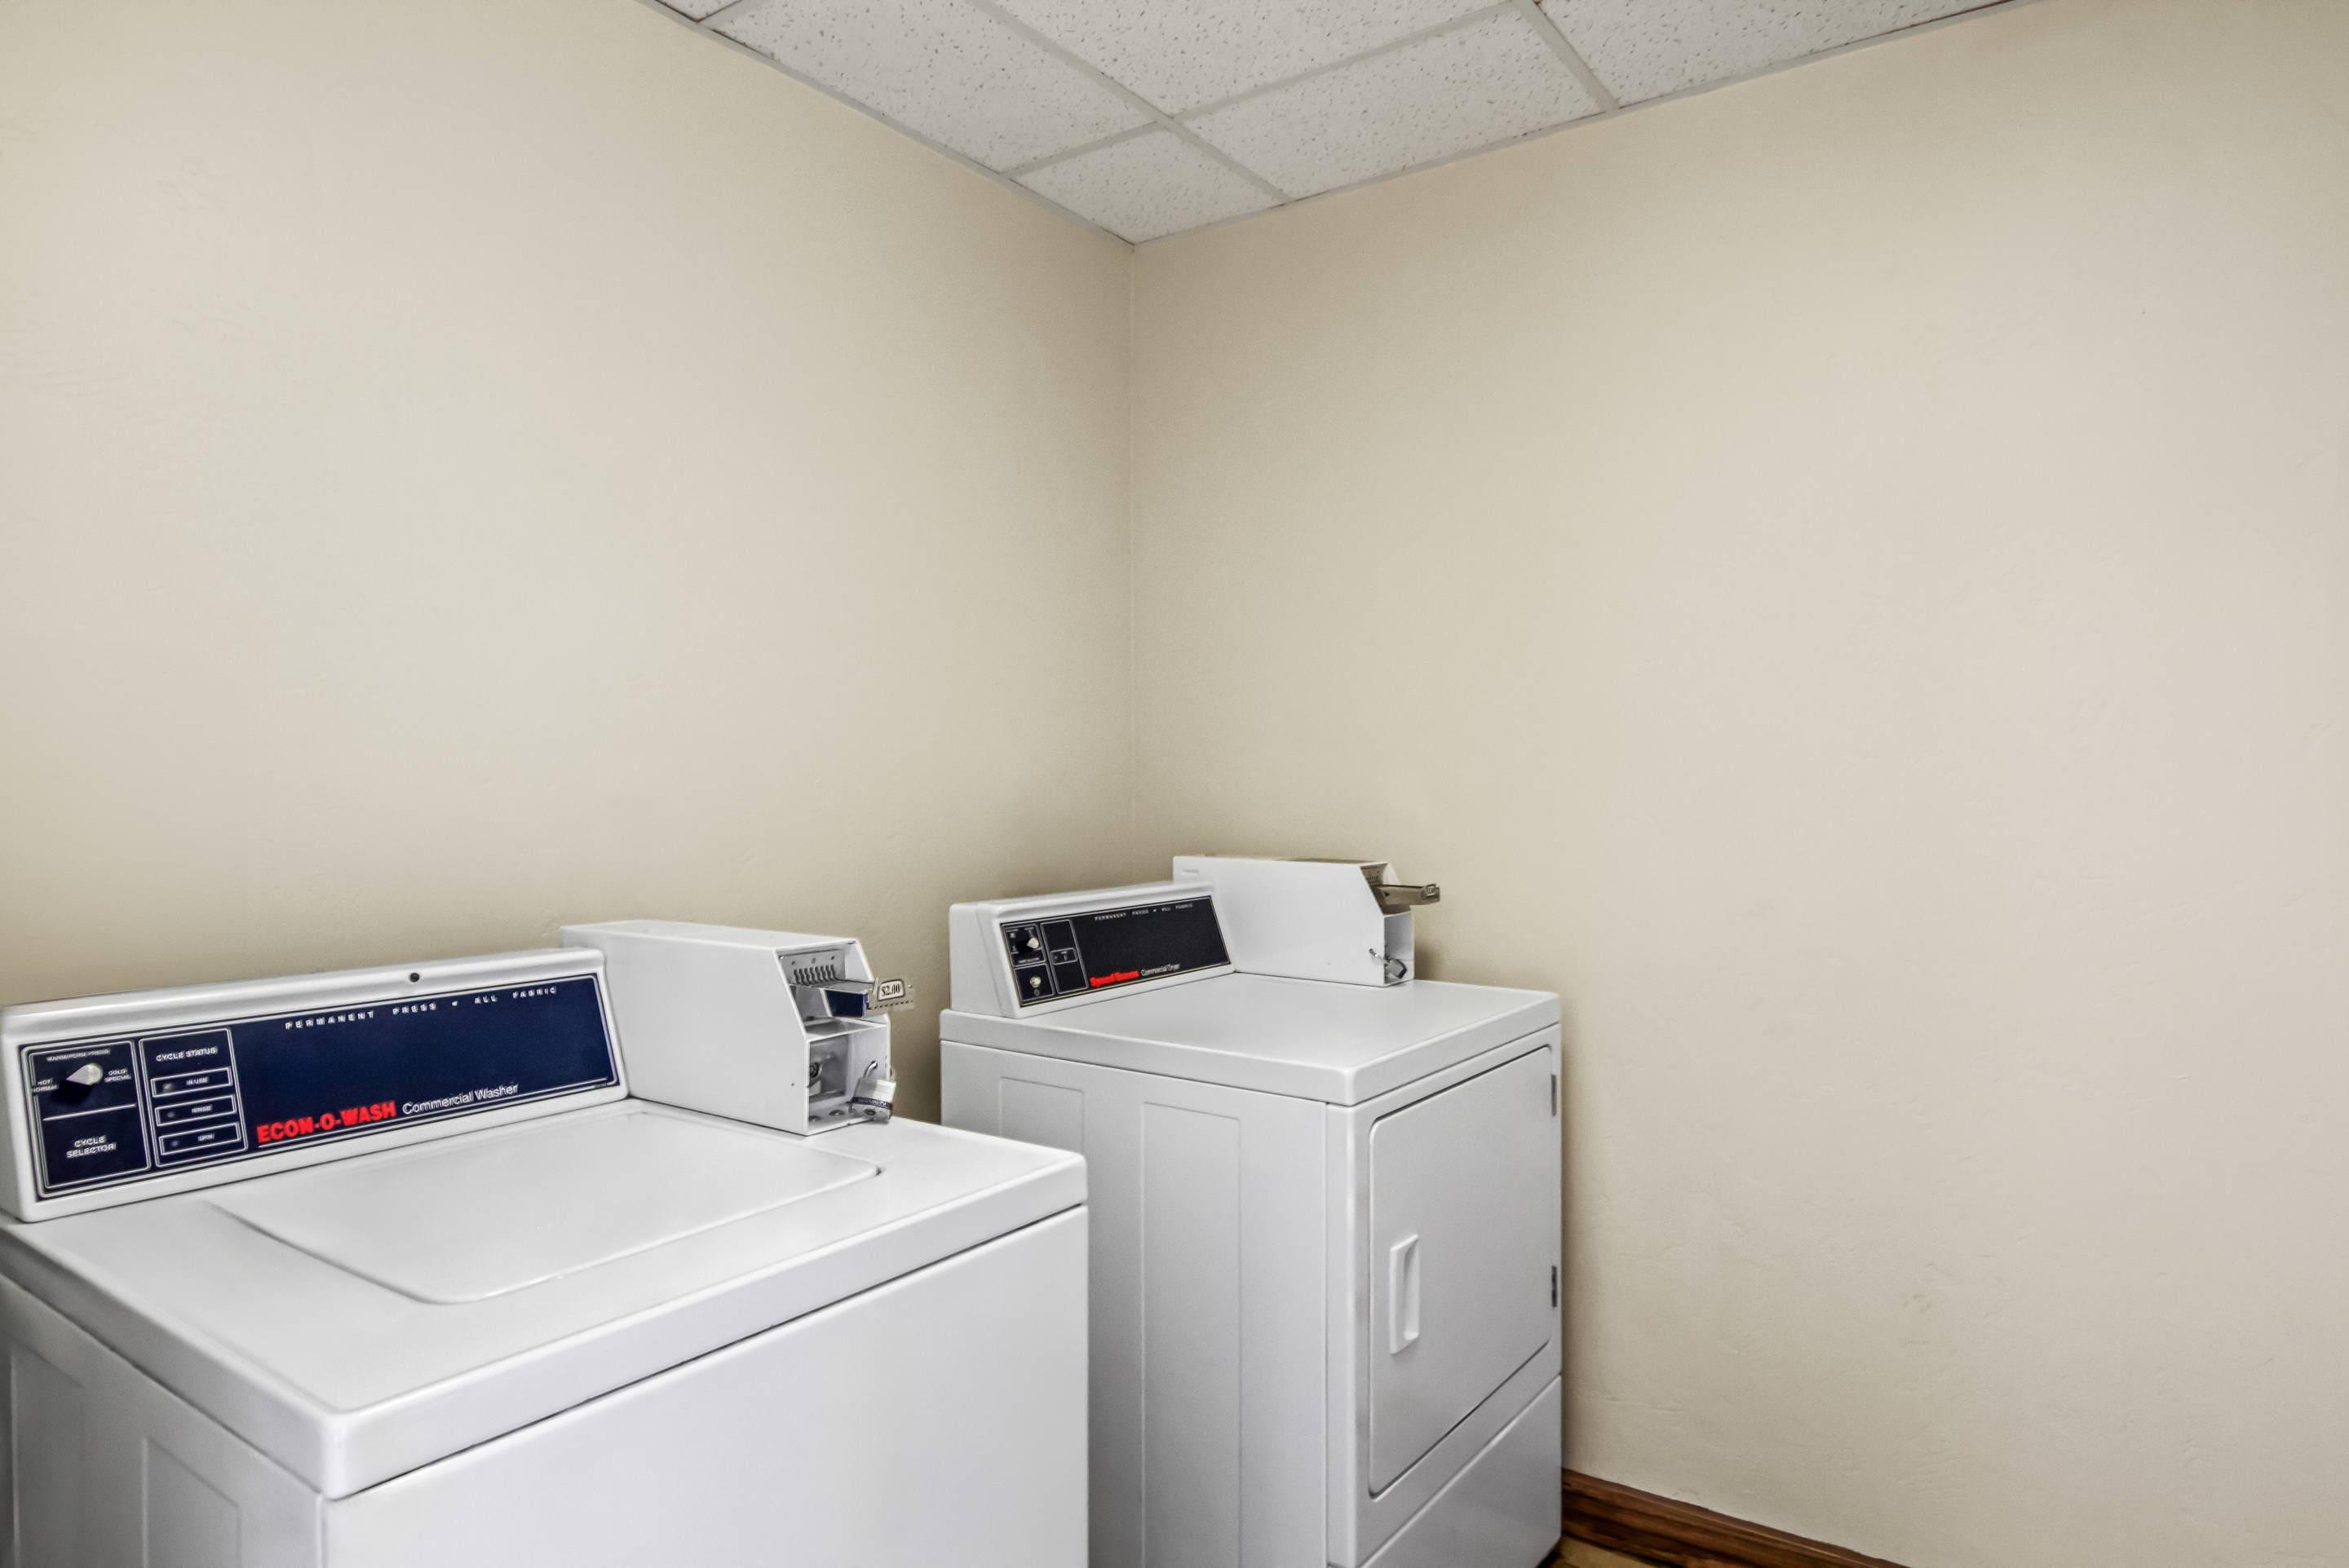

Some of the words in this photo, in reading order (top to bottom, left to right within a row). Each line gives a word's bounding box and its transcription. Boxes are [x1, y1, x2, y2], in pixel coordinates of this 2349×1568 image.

[285, 1010, 374, 1030] PERMANENT
[392, 1002, 436, 1015] PRESS
[475, 995, 498, 1004] ALL
[513, 987, 557, 999] FABRIC
[156, 1051, 184, 1062] CYCLE
[185, 1046, 218, 1058] STATUS
[256, 1101, 396, 1143] ECON-O-WASH
[402, 1091, 474, 1115] Commercial
[475, 1083, 519, 1101] Washer
[74, 1135, 106, 1147] CYCLE
[66, 1142, 117, 1159] SELECTOR
